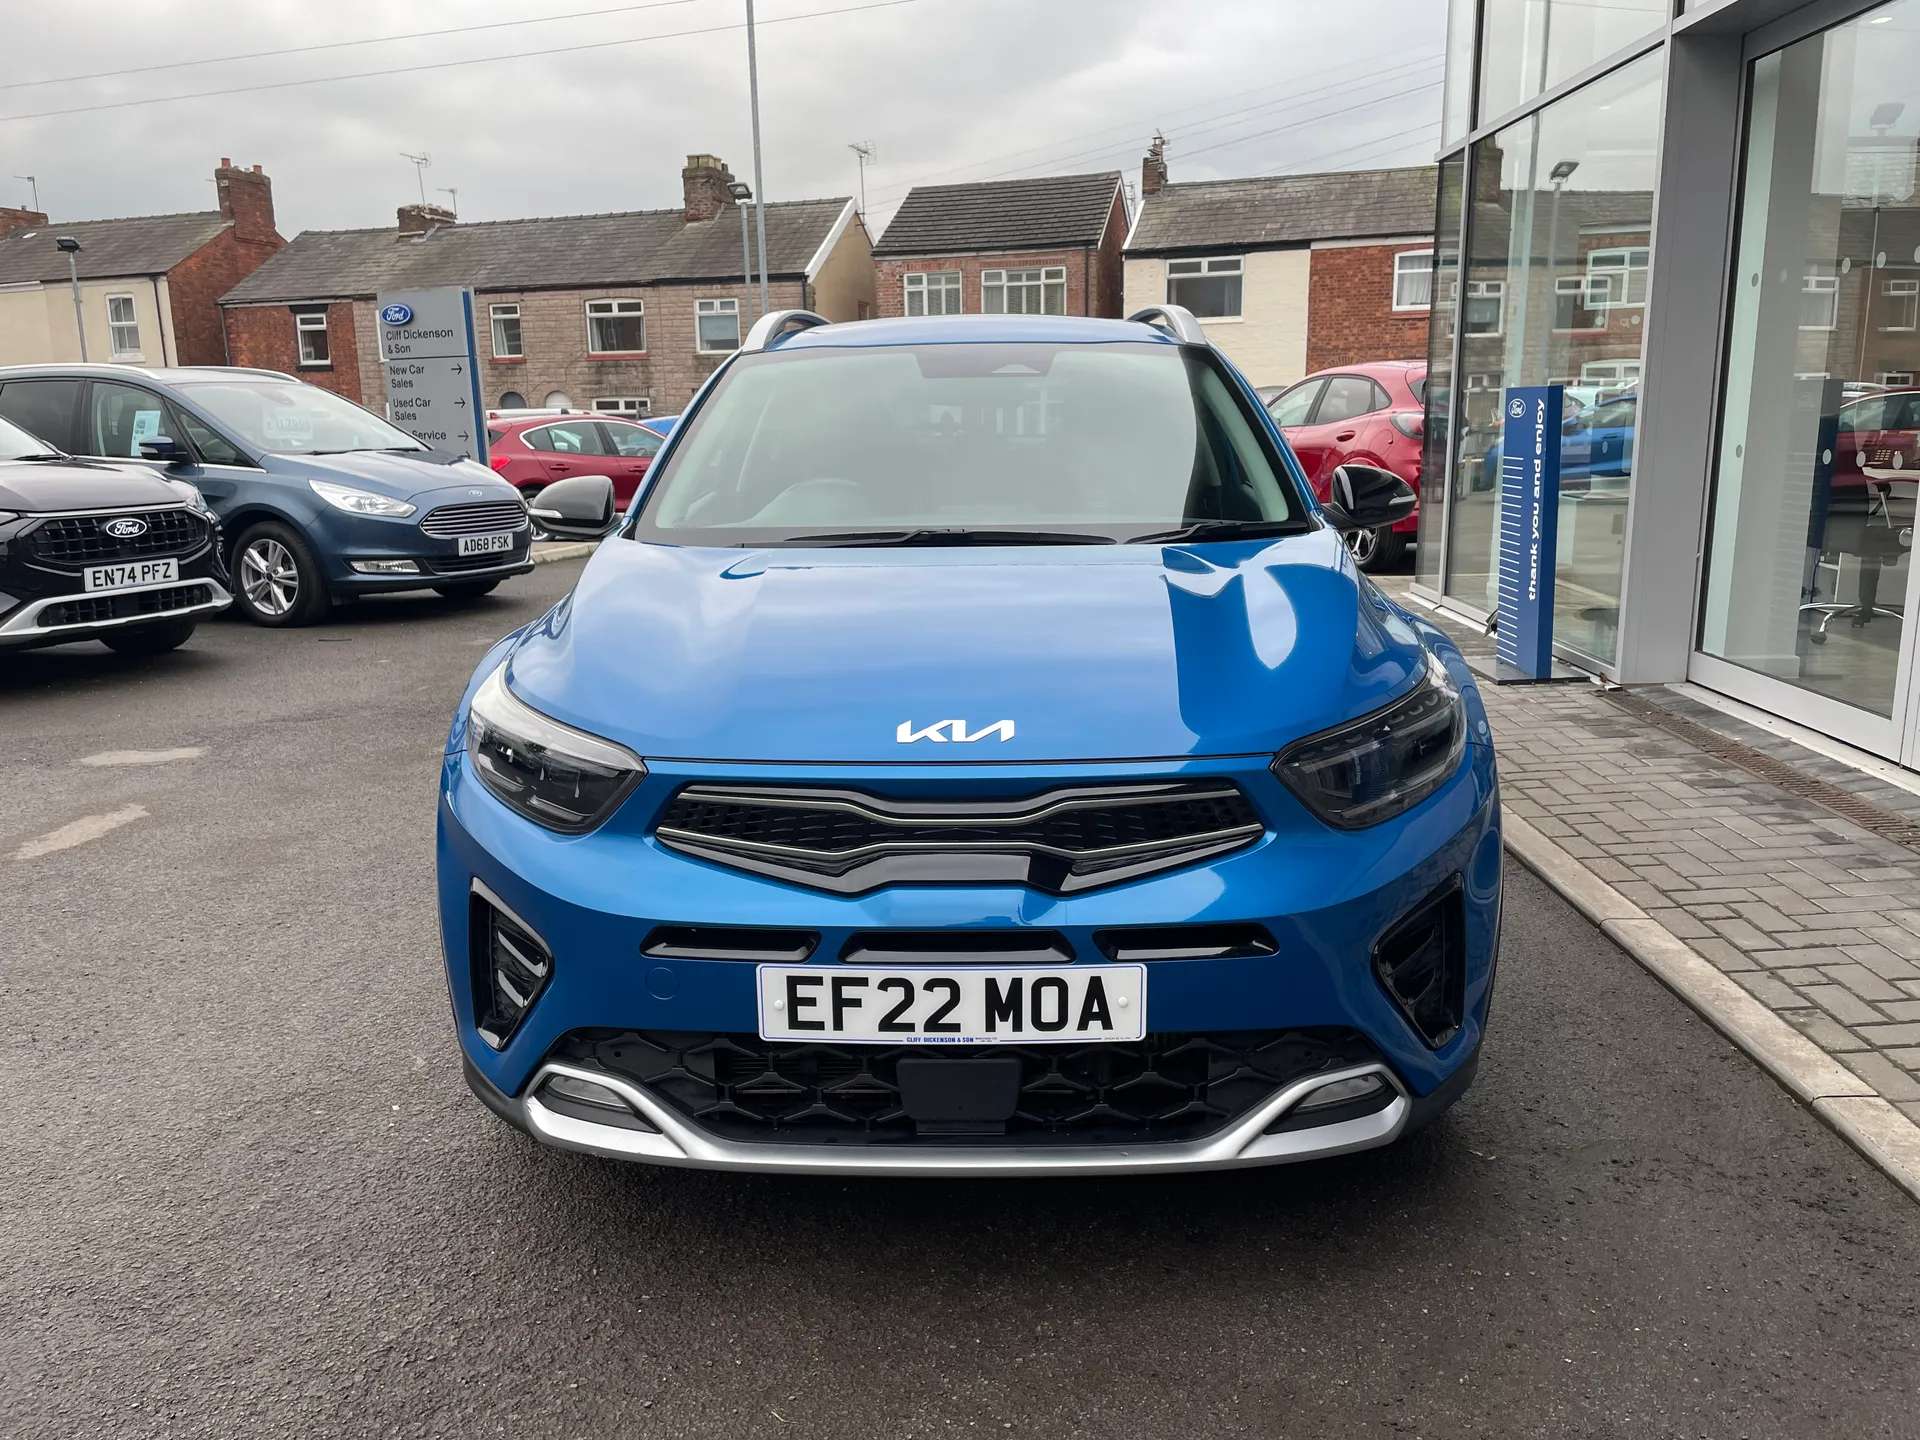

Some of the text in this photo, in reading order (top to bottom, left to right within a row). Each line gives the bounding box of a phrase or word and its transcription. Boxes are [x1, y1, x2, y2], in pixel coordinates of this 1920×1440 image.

[386, 308, 405, 321] Ford
[386, 328, 454, 341] Cliff Dickenson
[388, 344, 411, 354] & Son
[389, 364, 424, 376] New Car
[391, 379, 413, 388] Sales
[393, 397, 431, 408] Used Car
[394, 411, 417, 421] Sales
[1528, 399, 1545, 601] thank you and enjoy
[115, 522, 139, 534] Ford
[464, 535, 509, 553] AD68 FSK
[92, 562, 171, 588] EN74 PFZ
[786, 975, 1113, 1033] EF22 MOA
[923, 1036, 956, 1044] DICKENSON
